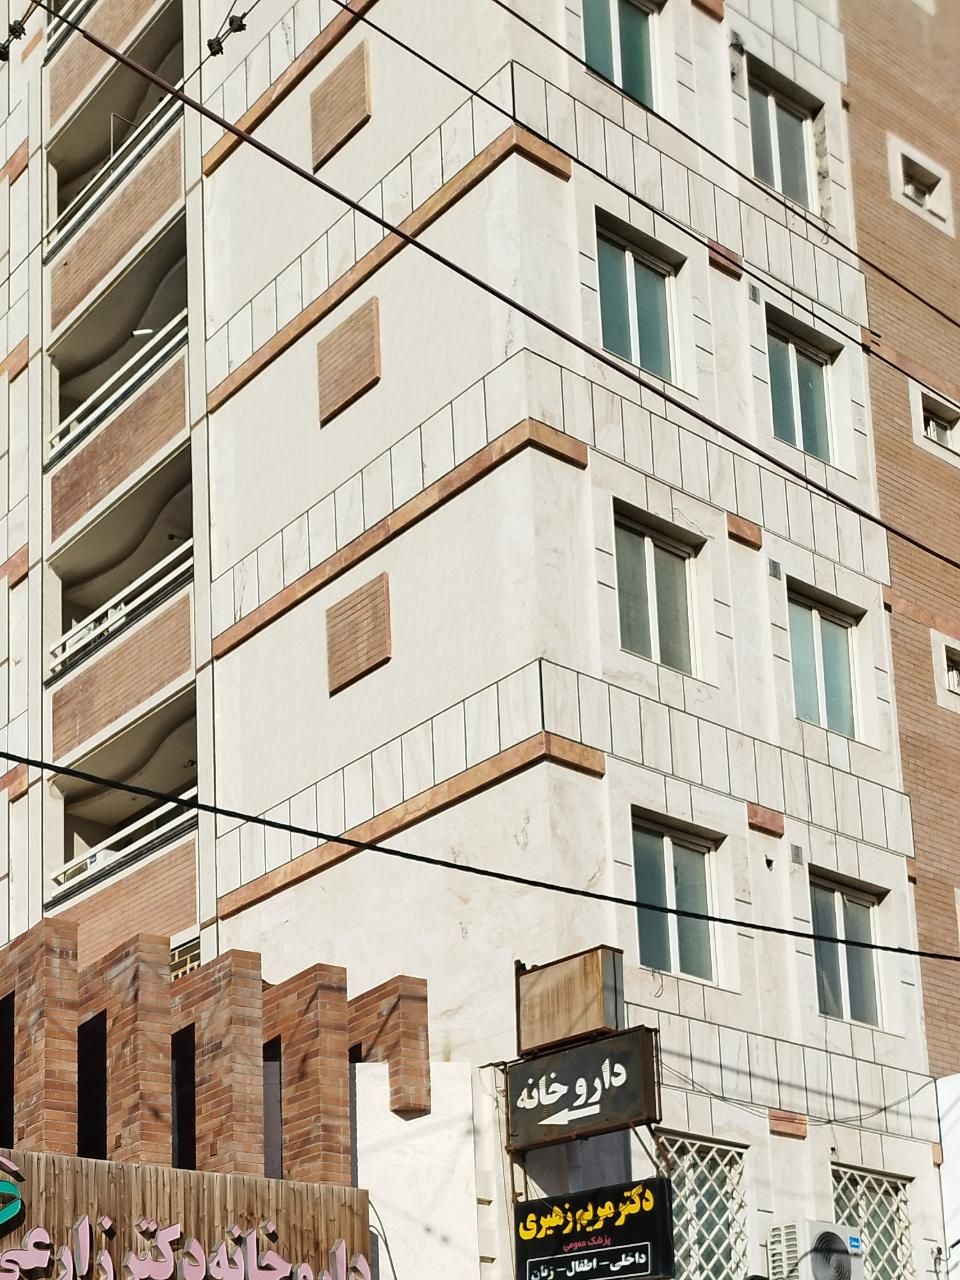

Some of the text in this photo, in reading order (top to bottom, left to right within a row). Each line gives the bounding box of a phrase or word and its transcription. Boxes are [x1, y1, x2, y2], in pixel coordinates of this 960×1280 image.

[518, 1184, 654, 1241] دکتر مریم زهیری
[562, 1235, 611, 1252] پزشک عمومی
[566, 1257, 597, 1277] اطفال
[609, 1251, 647, 1271] داخلی
